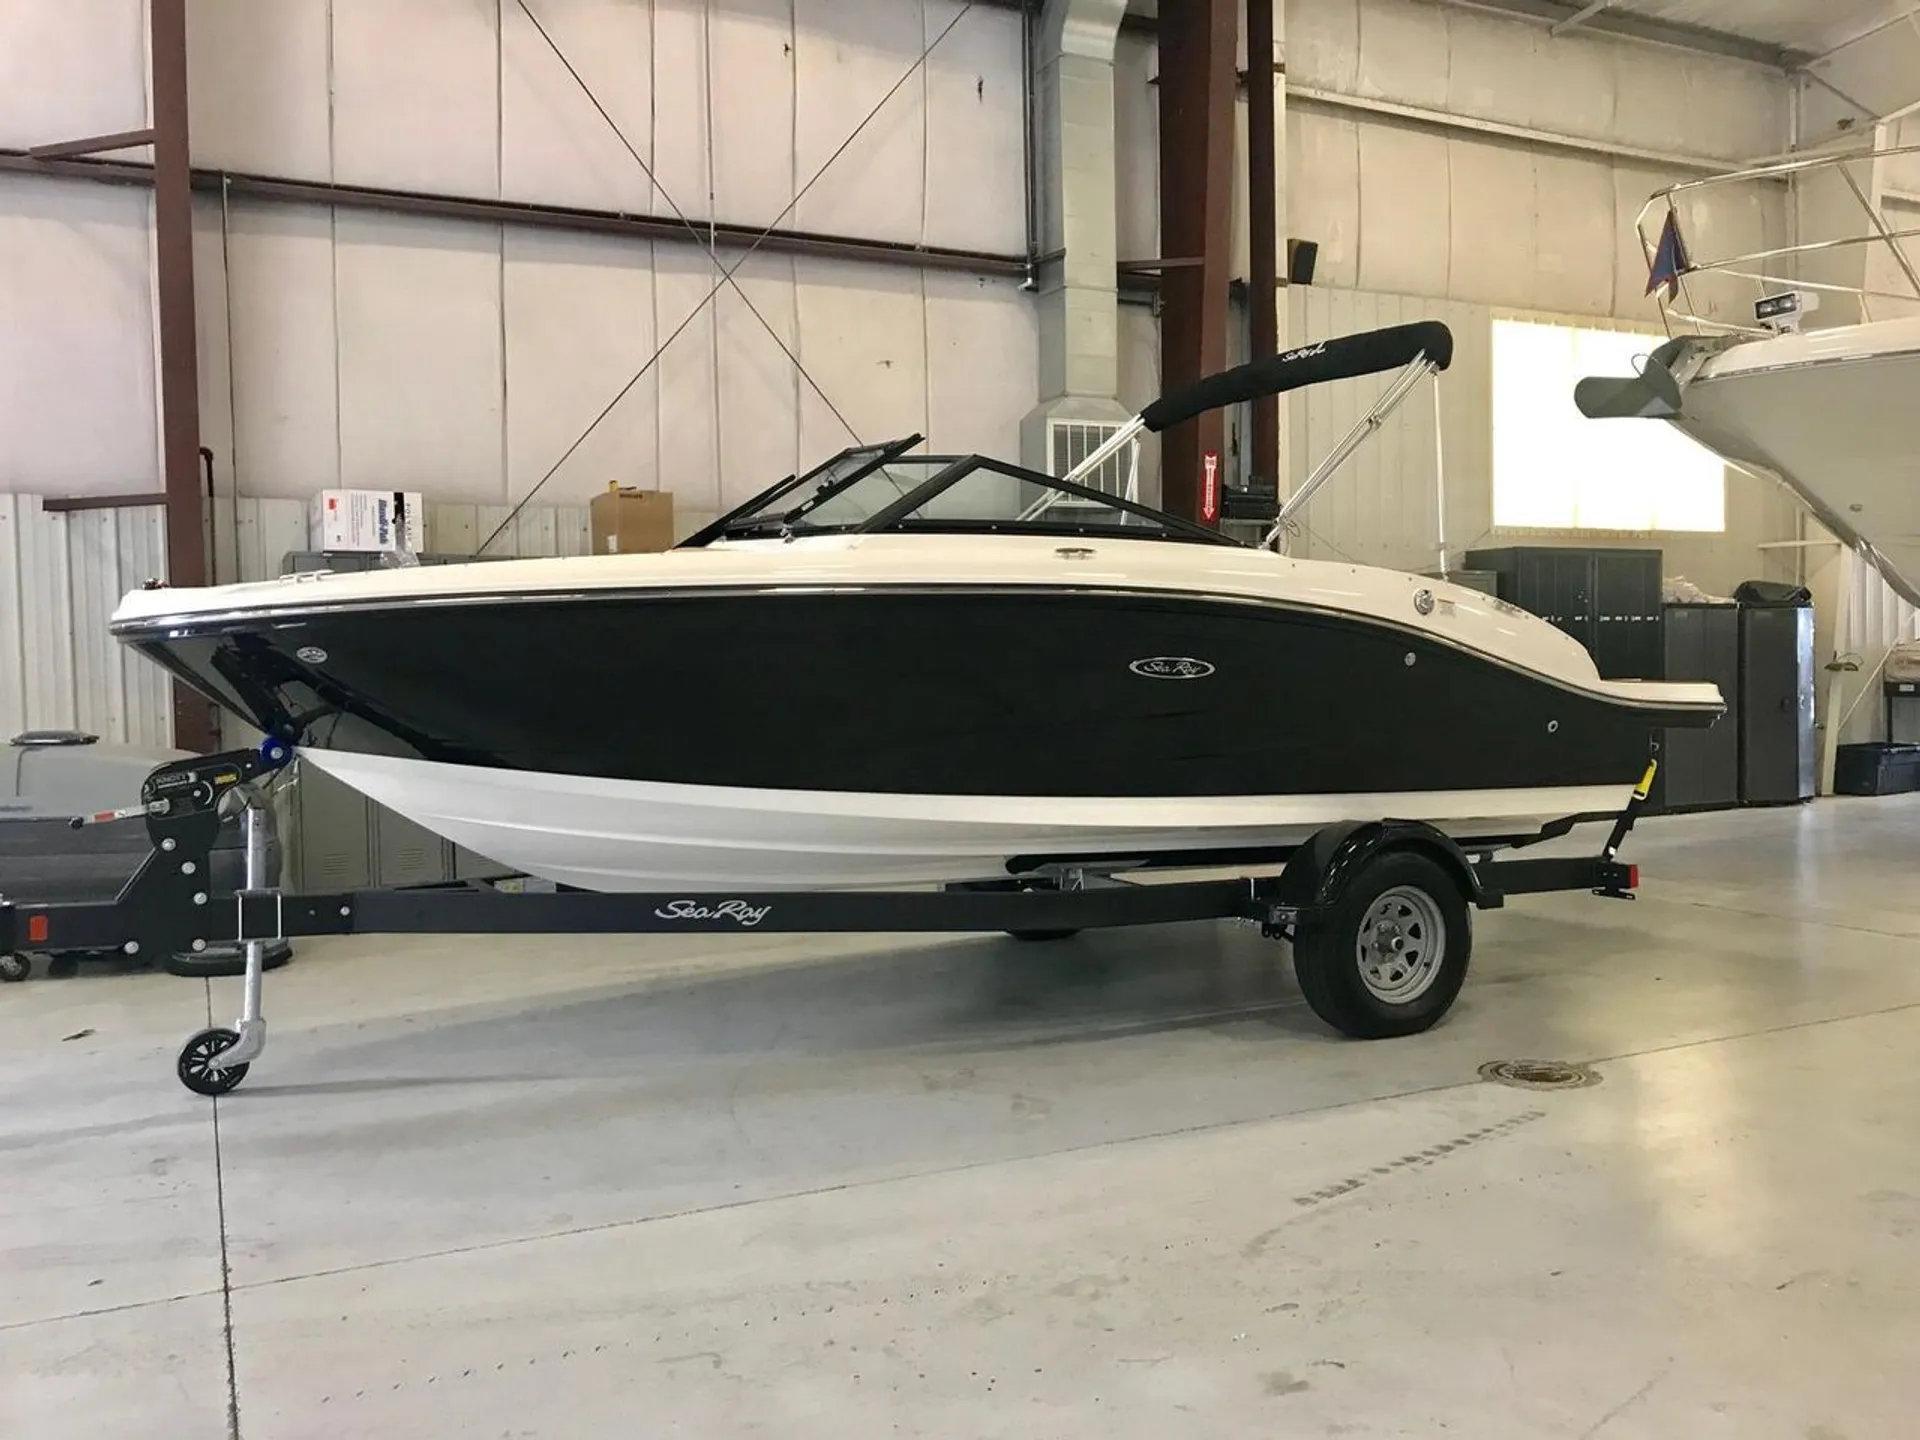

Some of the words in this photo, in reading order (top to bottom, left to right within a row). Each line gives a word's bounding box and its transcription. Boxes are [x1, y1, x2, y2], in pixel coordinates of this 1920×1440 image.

[1144, 661, 1171, 673] Sea
[1172, 661, 1201, 676] Ray
[654, 900, 714, 919] Sea
[712, 899, 773, 926] Ray
